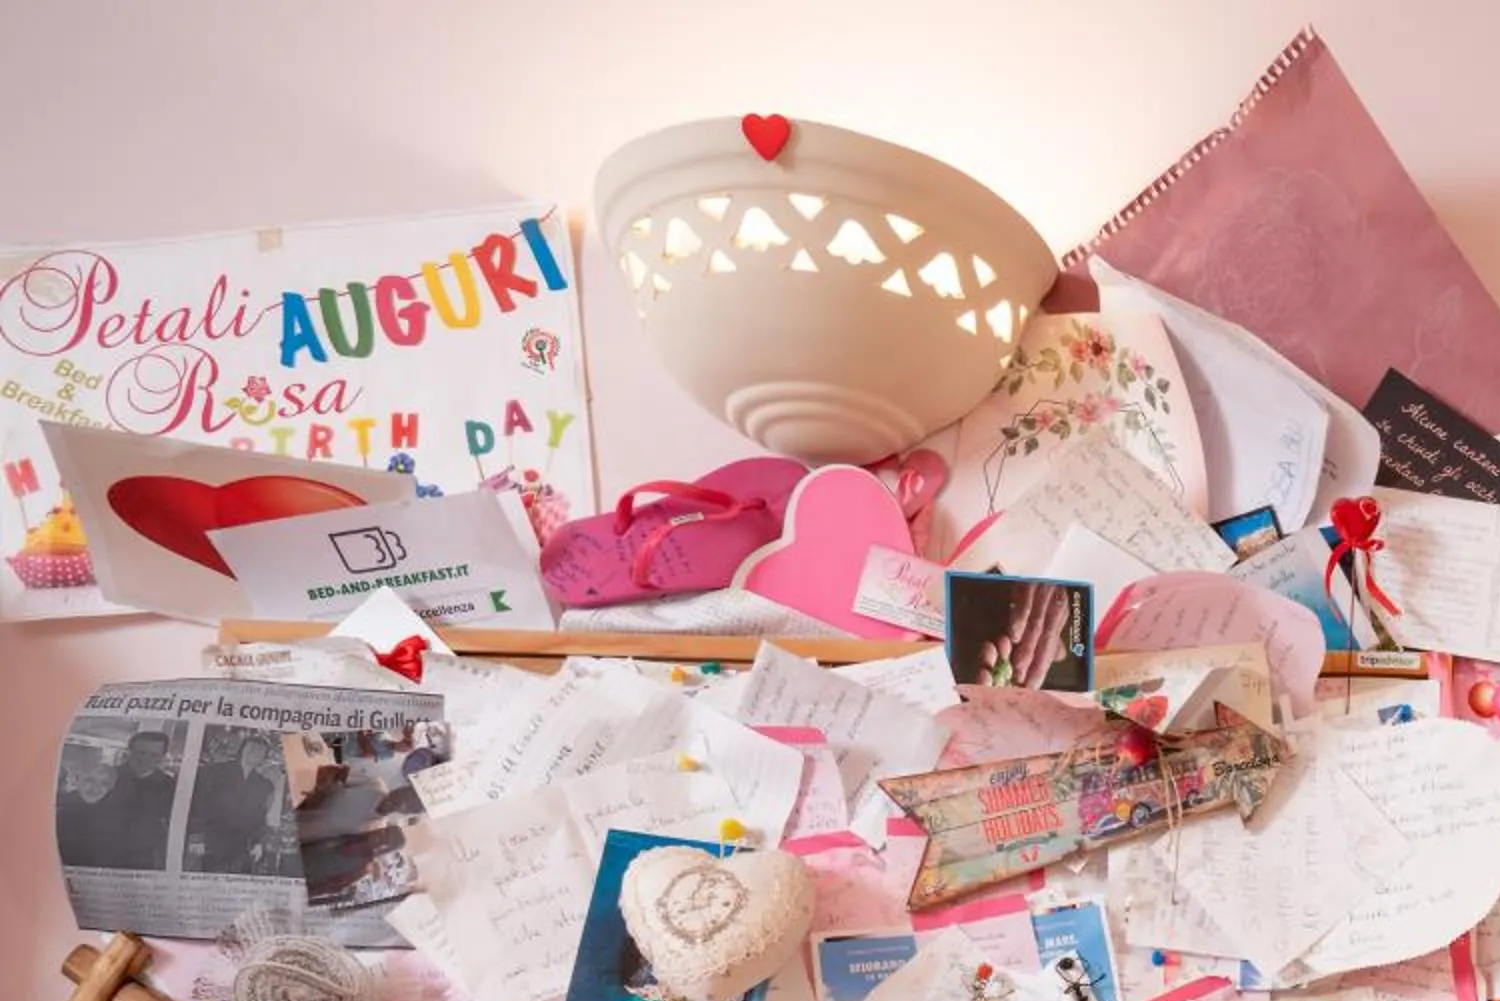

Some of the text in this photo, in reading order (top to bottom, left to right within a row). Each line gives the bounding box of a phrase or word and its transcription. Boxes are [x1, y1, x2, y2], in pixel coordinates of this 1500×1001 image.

[0, 250, 265, 356] Petali
[279, 218, 567, 368] AUGURI
[53, 359, 103, 389] Bed
[57, 382, 73, 400] &
[466, 400, 574, 456] DAY
[307, 564, 470, 600] BED-AND-BREAKFAST.IT
[84, 694, 125, 710] Tutti
[125, 693, 176, 714] pazzi
[177, 699, 212, 717] per
[218, 695, 233, 717] la
[239, 702, 341, 730] compagnia
[347, 709, 364, 729] di
[989, 761, 1030, 786] enjoy
[978, 778, 1052, 813] SUMMER
[983, 806, 1064, 844] HOLIDAYS
